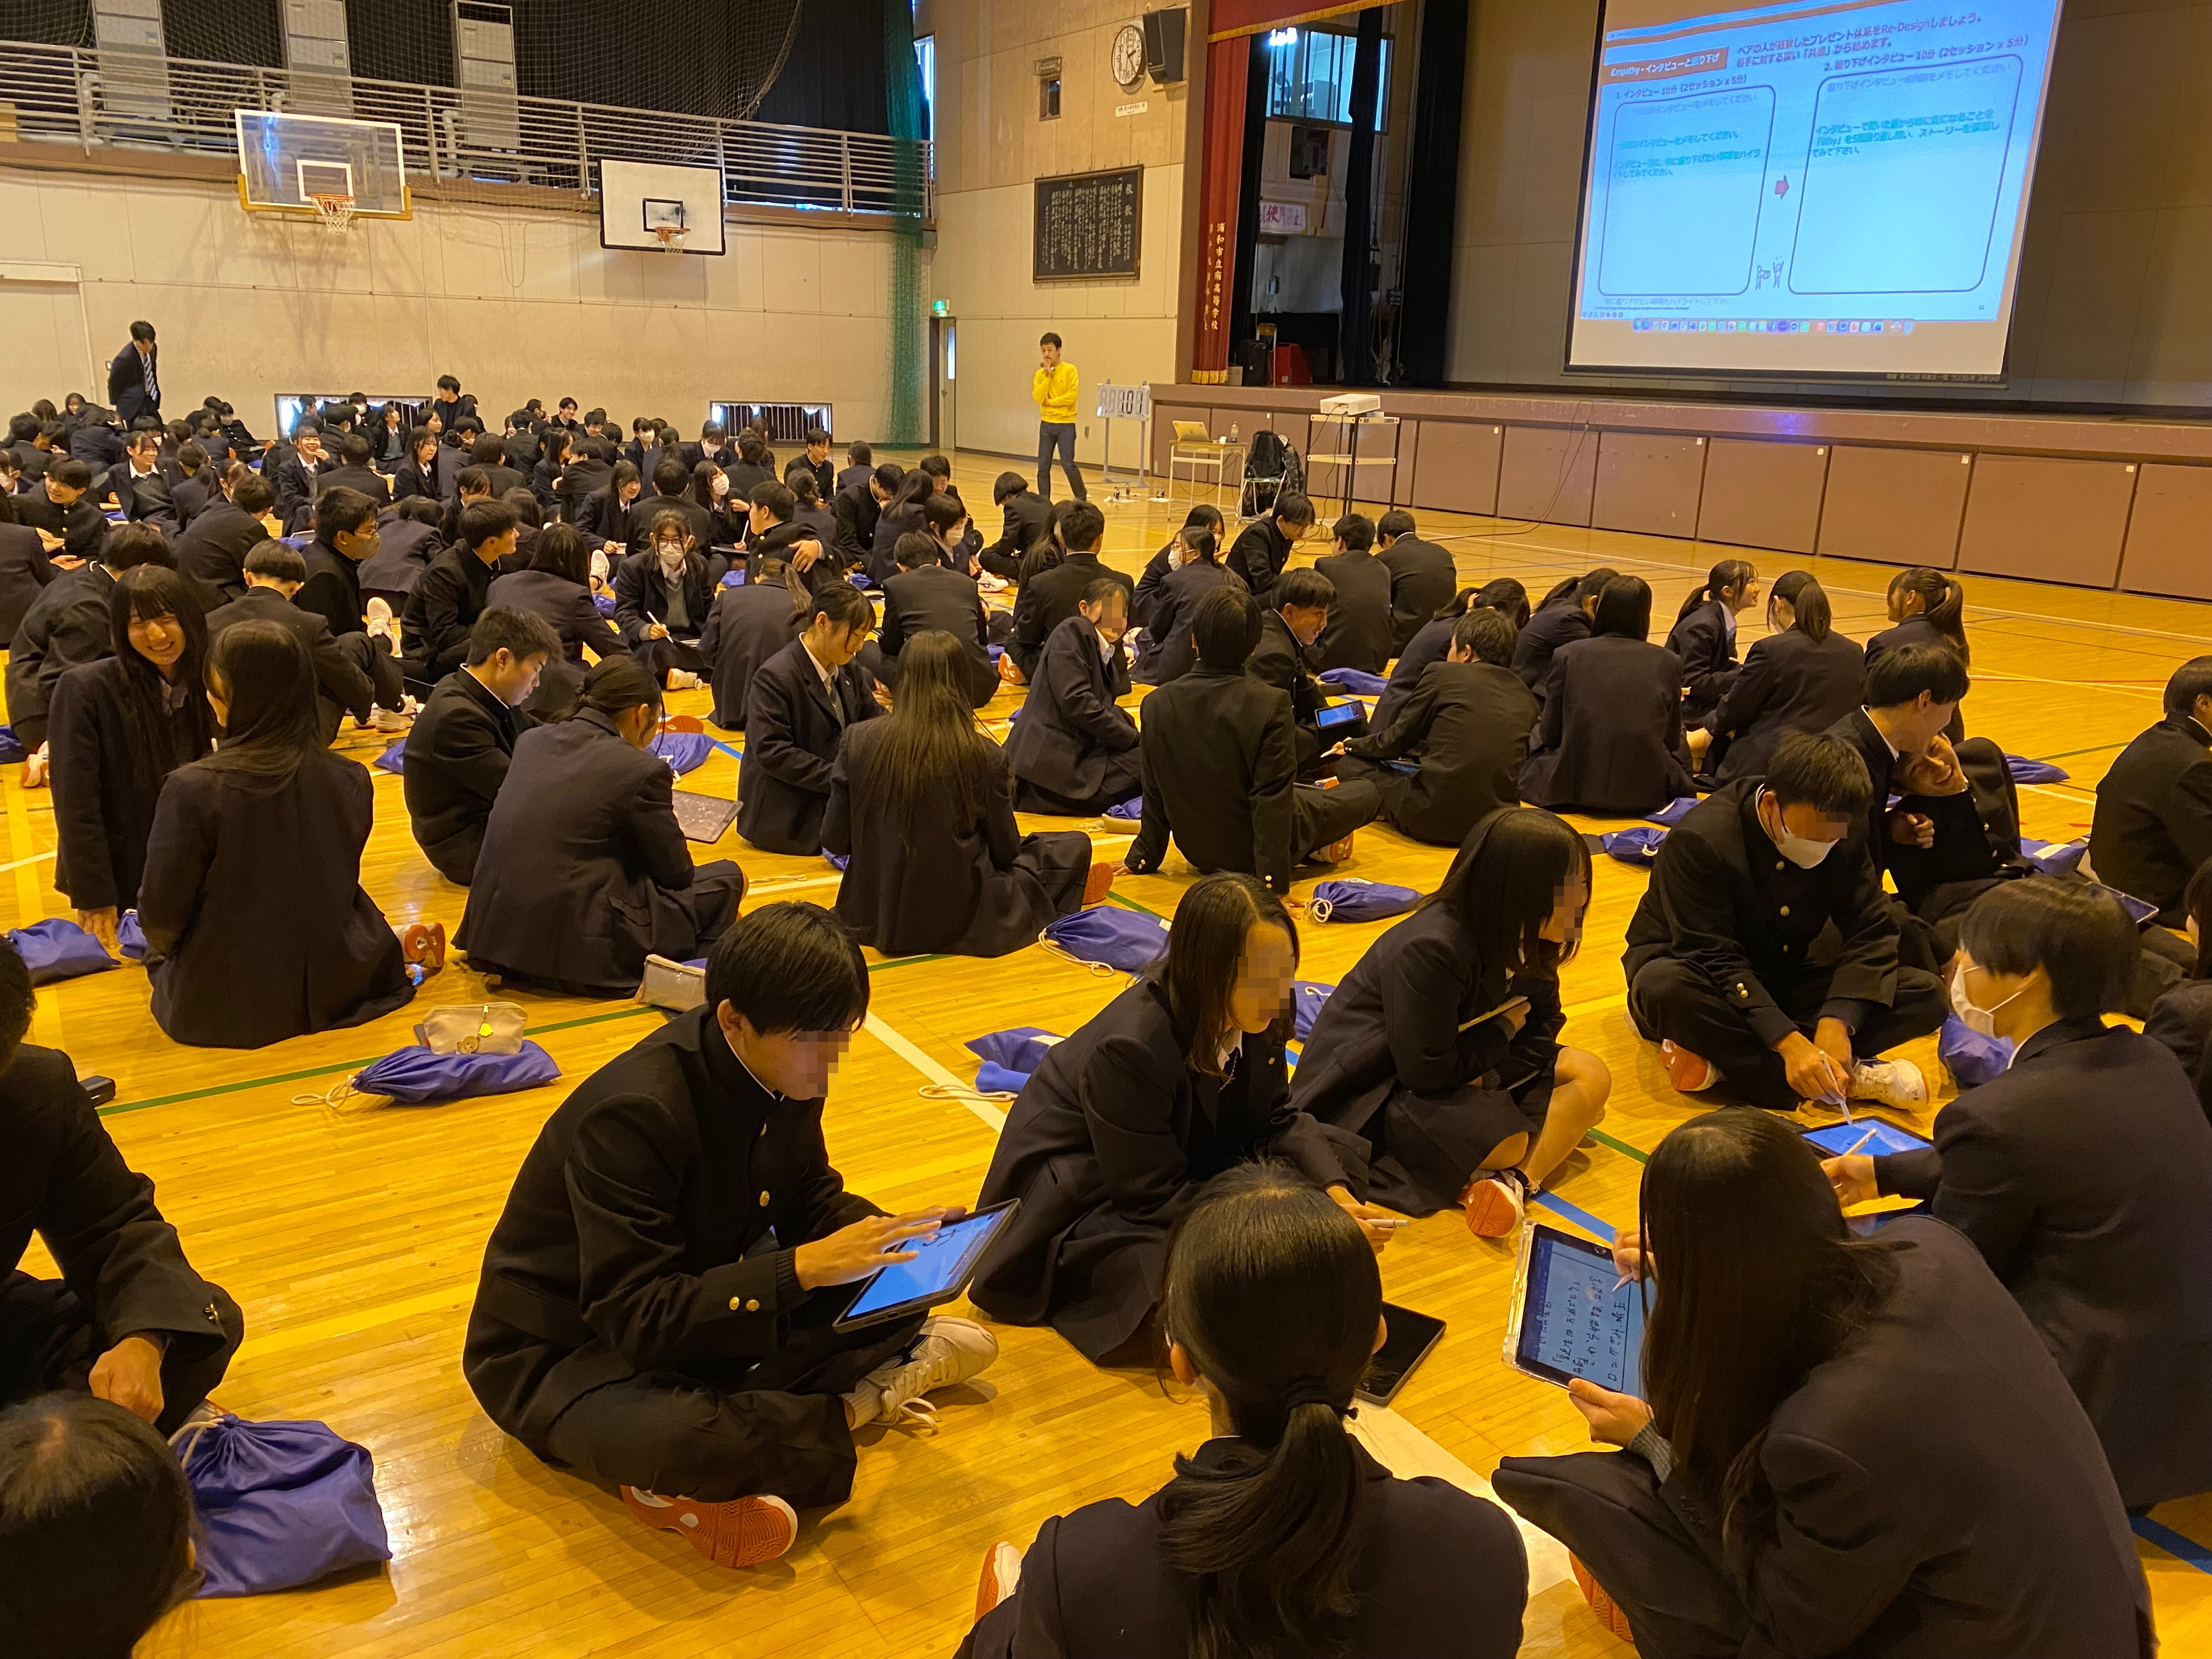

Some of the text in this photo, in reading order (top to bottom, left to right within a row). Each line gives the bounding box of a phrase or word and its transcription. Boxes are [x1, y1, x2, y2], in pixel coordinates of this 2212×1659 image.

[1128, 32, 1133, 42] 12
[1118, 44, 1124, 53] 10
[1137, 40, 1141, 48] 2
[1611, 66, 1640, 76] Empathy
[1624, 89, 1660, 99] インタビュー
[1211, 222, 1225, 330] 浦和市立南高等学校
